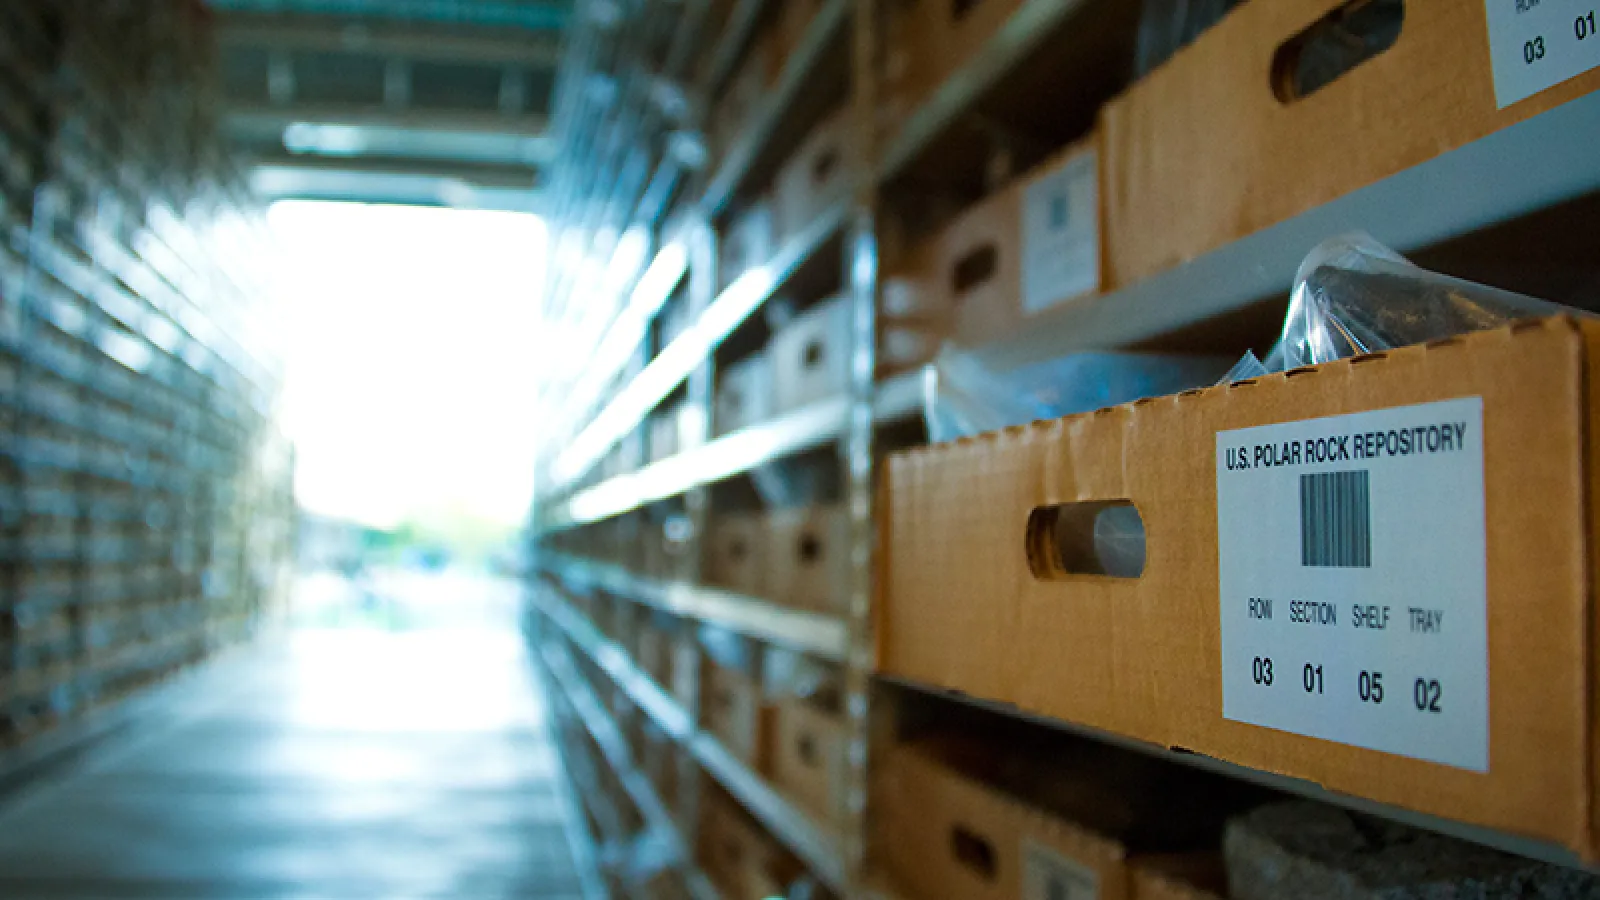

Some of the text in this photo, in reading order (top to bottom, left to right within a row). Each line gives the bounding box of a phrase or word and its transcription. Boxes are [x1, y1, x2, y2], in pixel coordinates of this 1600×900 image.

[1524, 10, 1596, 64] 03 01
[1226, 422, 1466, 470] U.S. POLAR ROCK REPOSITORY
[1248, 598, 1443, 632] ROW SECTION SHELF TRAY
[1253, 656, 1442, 713] 03 01 05 02
